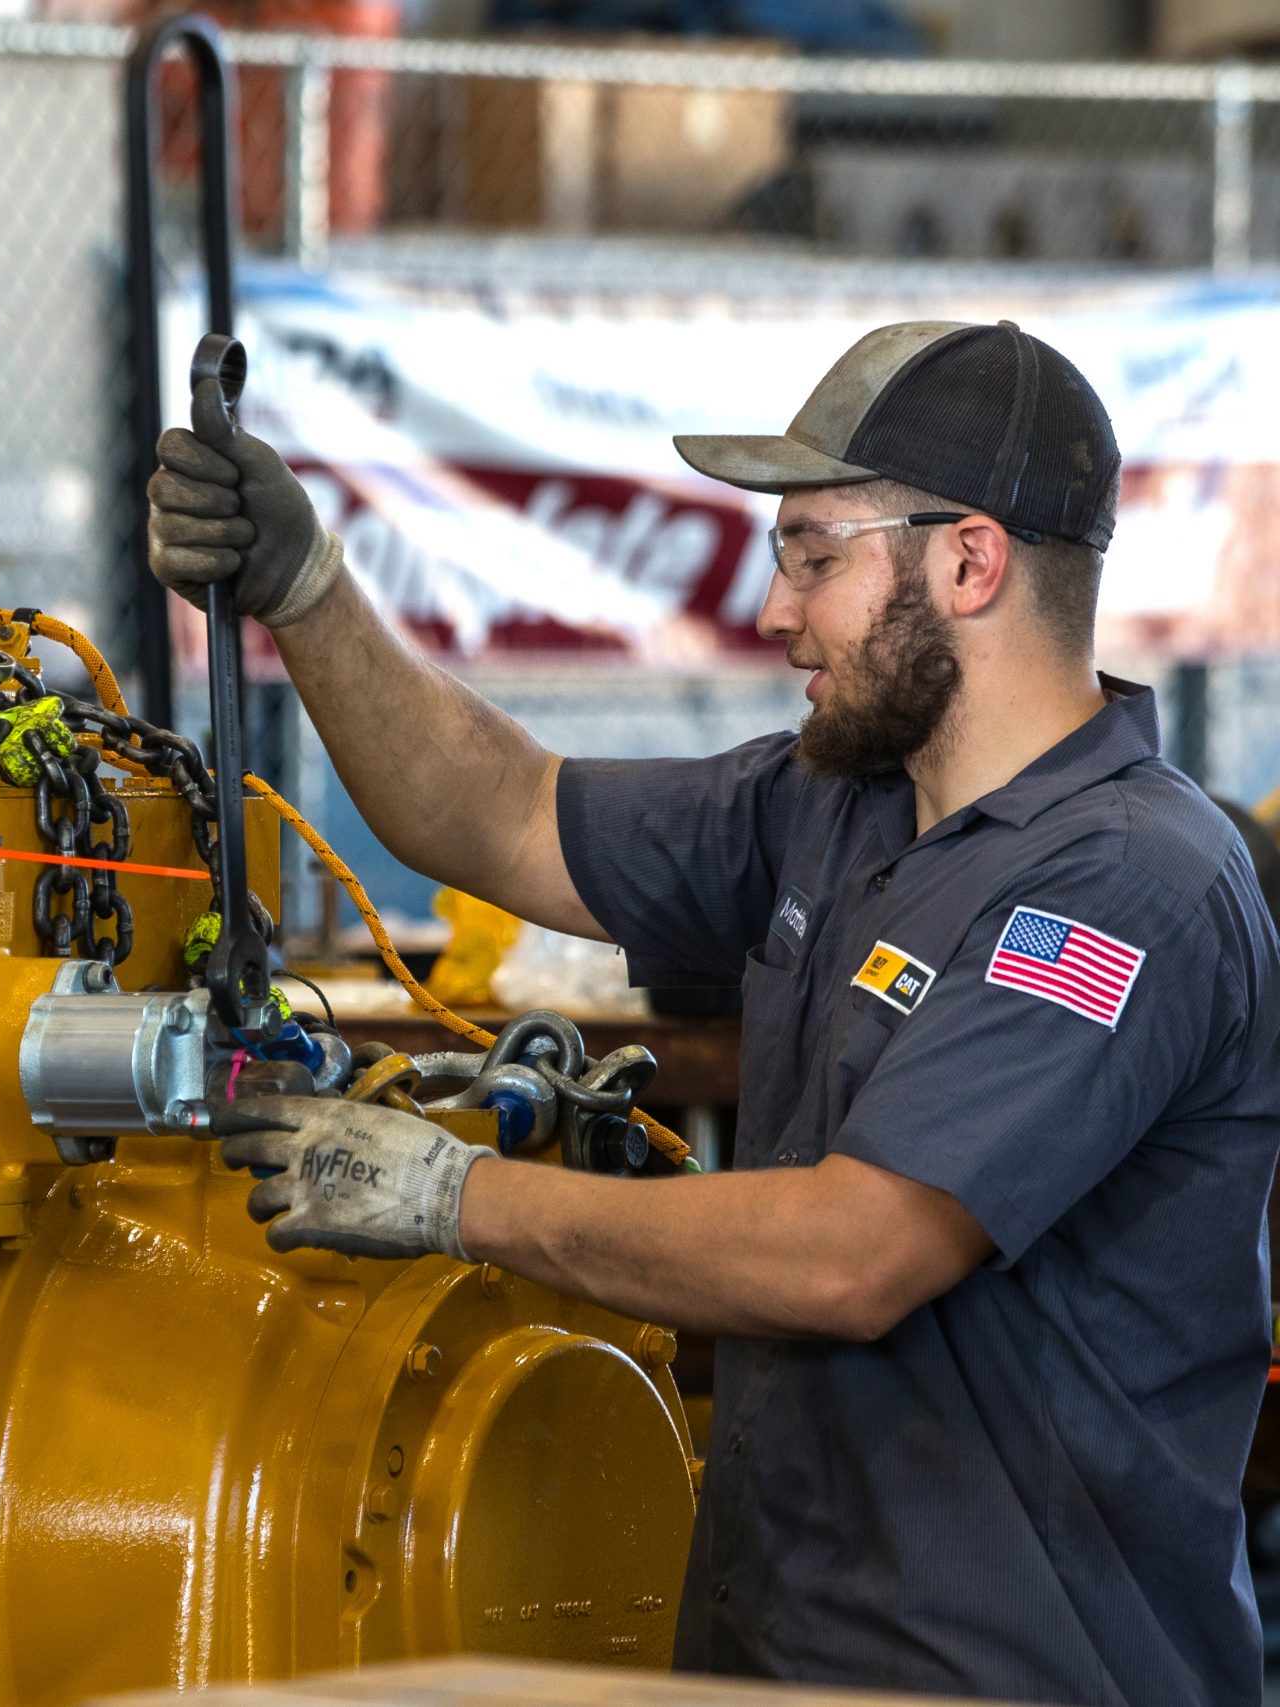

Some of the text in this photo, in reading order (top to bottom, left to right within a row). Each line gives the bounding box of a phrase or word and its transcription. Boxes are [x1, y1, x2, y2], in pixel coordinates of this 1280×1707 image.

[895, 973, 920, 997] CAT
[300, 1145, 381, 1189] HyFlex
[422, 1136, 448, 1167] Ansell
